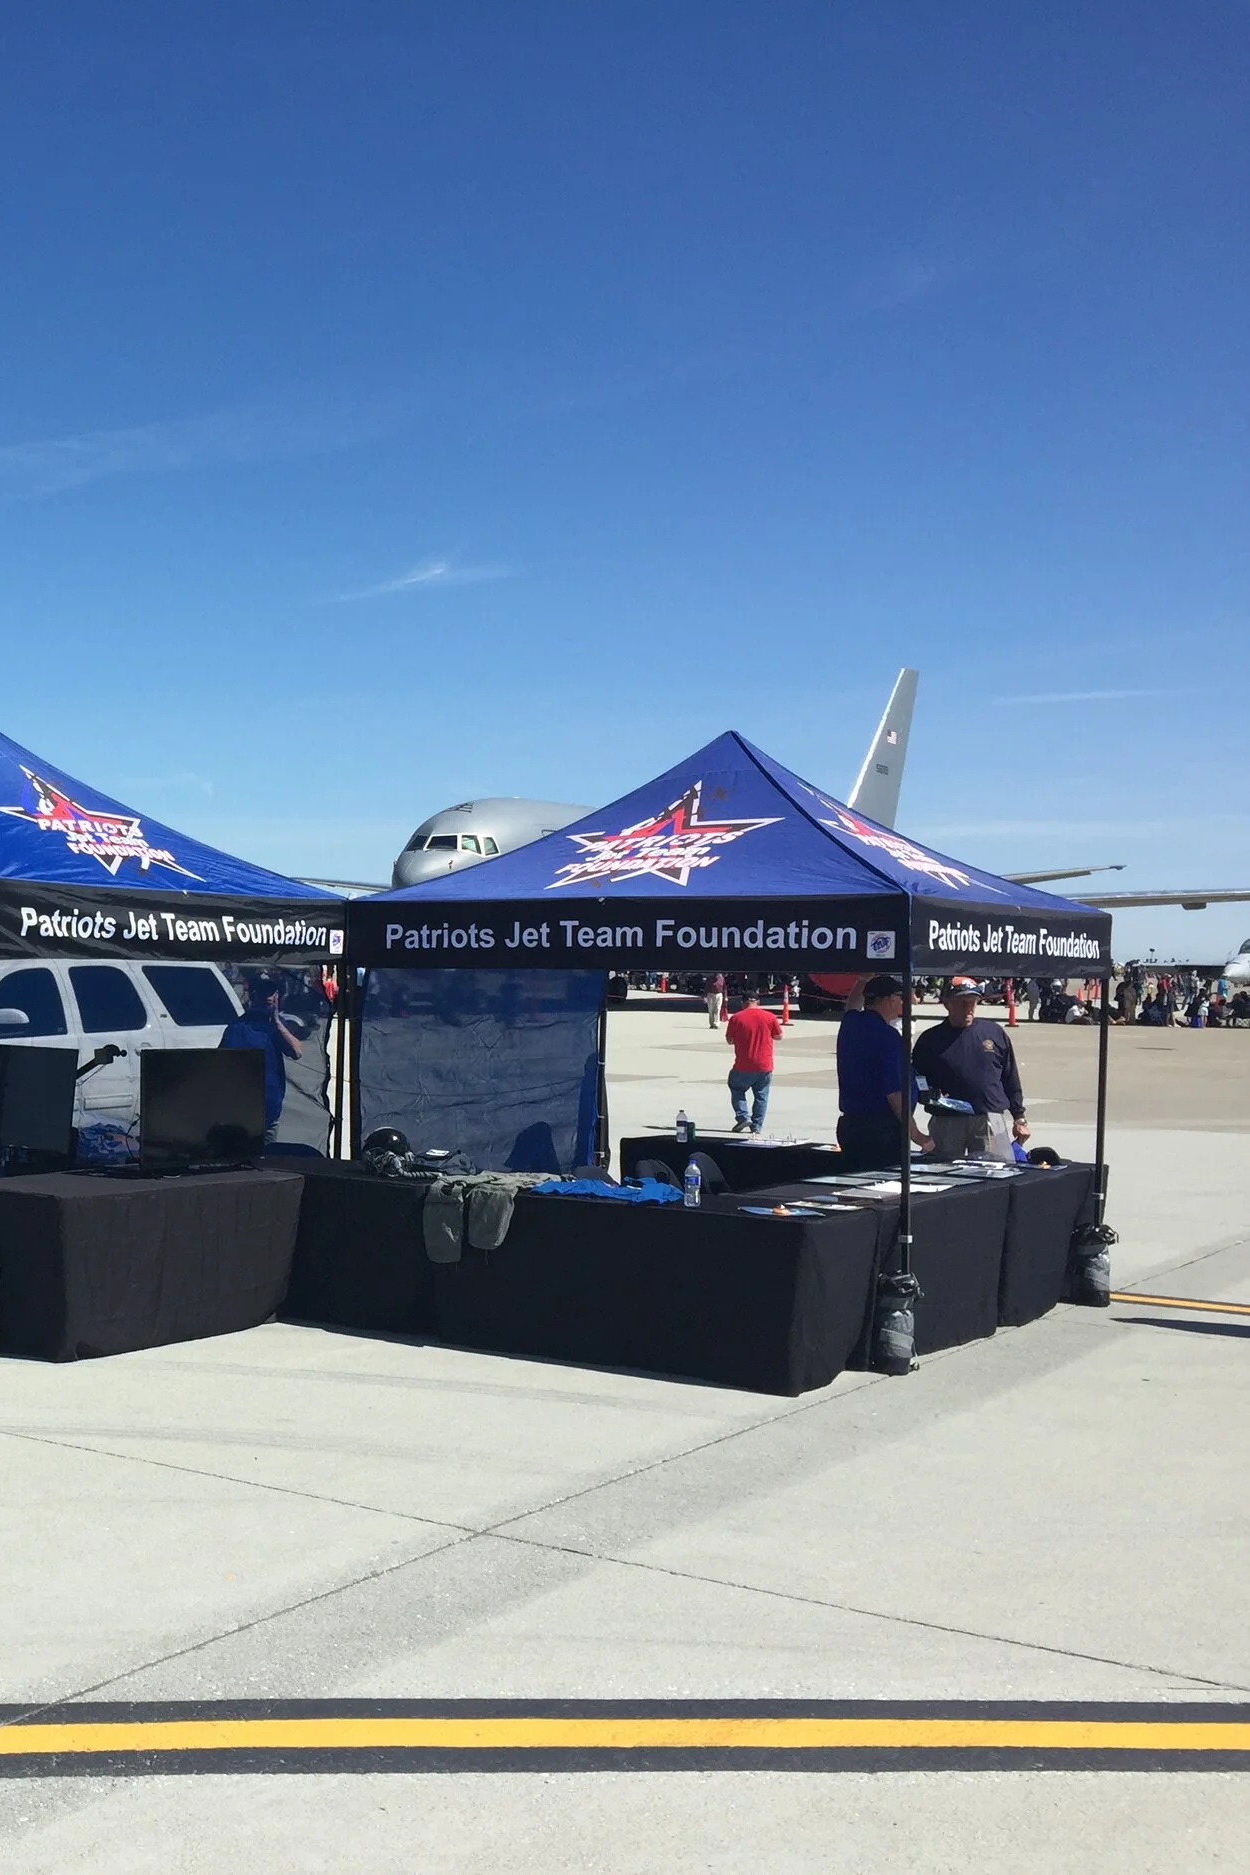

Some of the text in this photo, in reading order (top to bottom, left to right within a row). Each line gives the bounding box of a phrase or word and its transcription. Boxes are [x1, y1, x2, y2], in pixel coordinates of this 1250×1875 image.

[37, 818, 144, 837] PATRIOTS
[66, 842, 176, 861] FOUNDATION
[576, 831, 745, 854] PATRIOTS
[554, 855, 721, 875] FOUNDATION
[20, 906, 327, 947] Patriots Jet Team Foundation
[386, 922, 495, 949] Patriots
[504, 921, 550, 948] Jet
[559, 920, 643, 948] Team
[655, 919, 857, 950] Foundation
[928, 919, 981, 952] Patriots
[982, 923, 1004, 953] Jet
[1005, 925, 1037, 955] Team
[1038, 928, 1101, 960] Foundation
